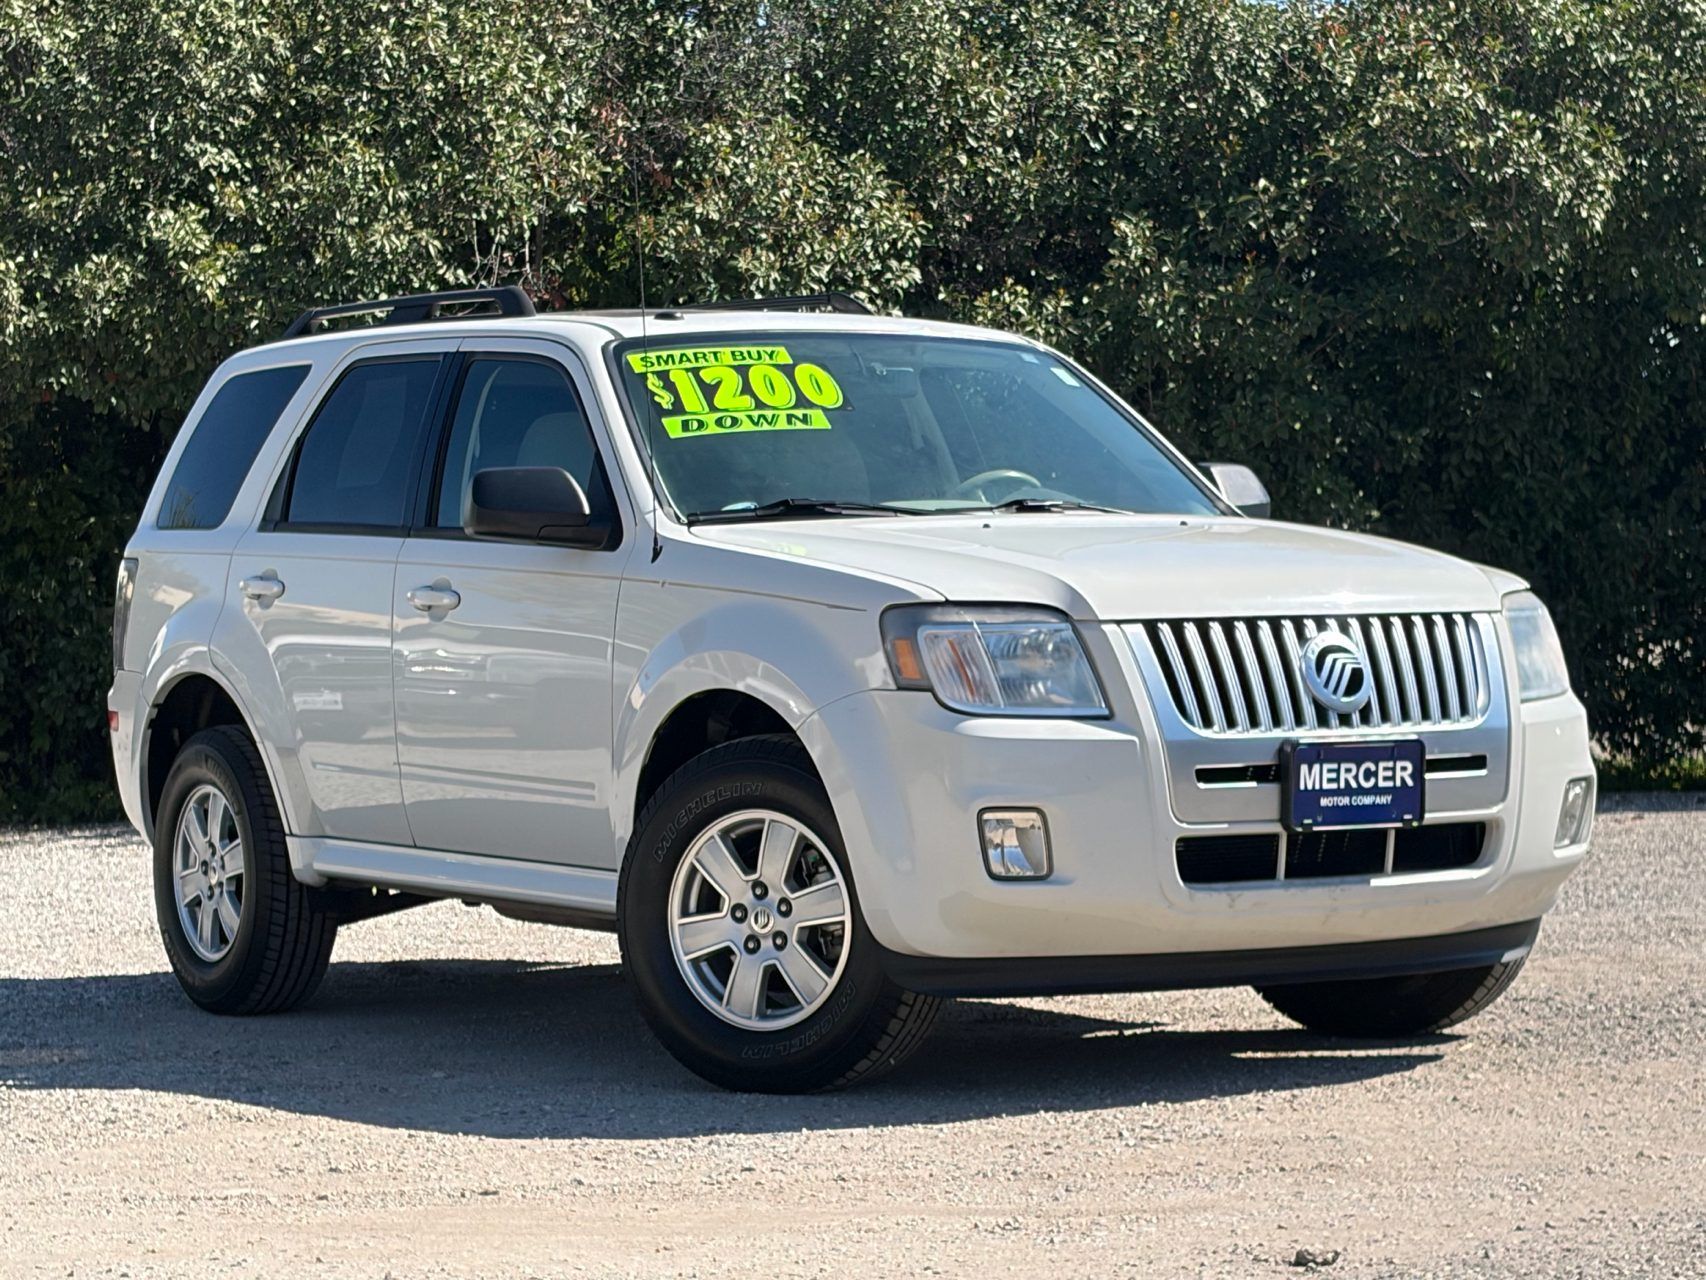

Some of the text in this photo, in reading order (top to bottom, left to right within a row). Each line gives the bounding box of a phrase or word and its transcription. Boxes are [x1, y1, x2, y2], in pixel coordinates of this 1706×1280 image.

[639, 349, 779, 368] SMART BUY
[646, 363, 843, 414] $1200
[680, 412, 813, 433] DOWN
[1299, 760, 1414, 790] MERCER
[1320, 794, 1392, 807] MOTOR COMPANY
[653, 782, 763, 863] MICHELIN
